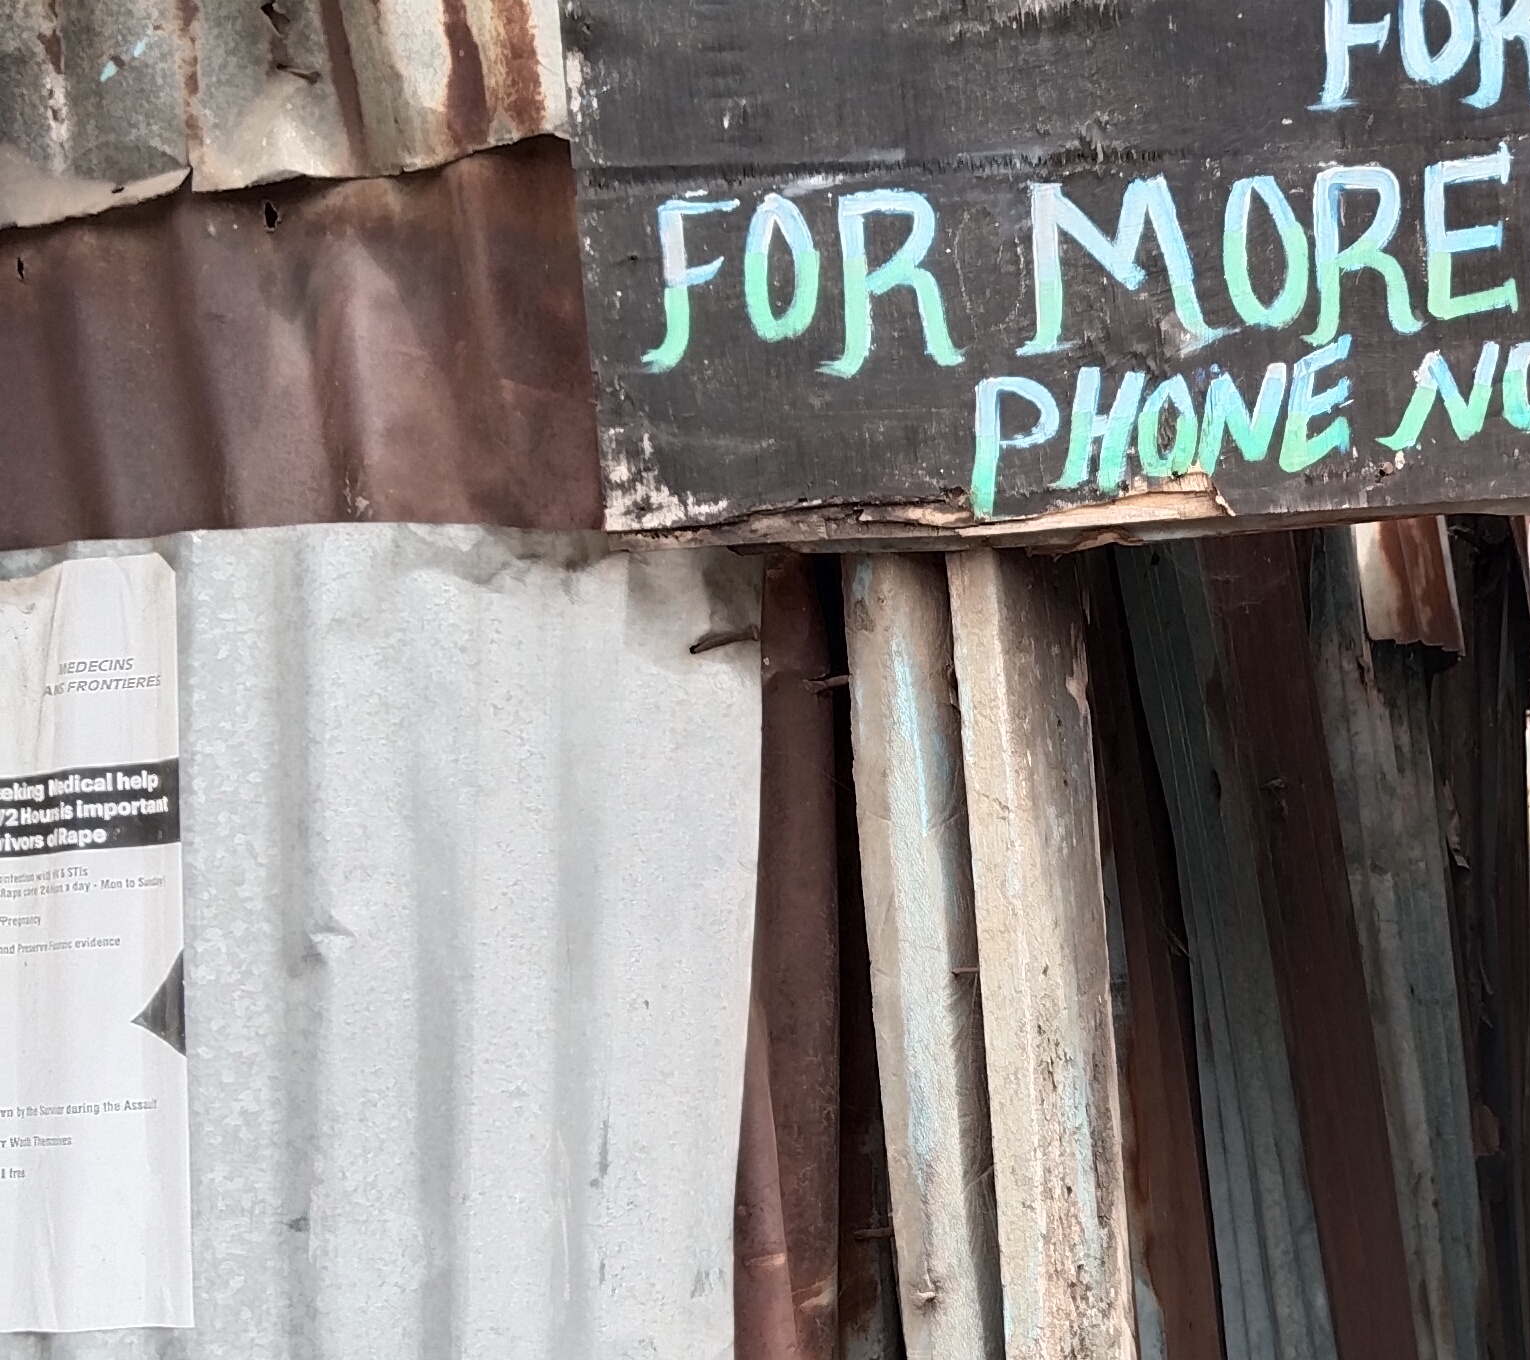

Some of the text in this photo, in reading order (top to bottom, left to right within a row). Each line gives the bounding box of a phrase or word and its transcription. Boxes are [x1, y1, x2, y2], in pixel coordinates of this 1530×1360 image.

[640, 187, 966, 379] FOR
[1015, 140, 1519, 356] MORE
[971, 334, 1353, 518] PHONE
[66, 674, 162, 693] FRONTIERES
[48, 772, 113, 798] Medical
[116, 769, 159, 792] help
[76, 795, 169, 821] important
[58, 827, 108, 848] Rape
[100, 878, 123, 890] Mon
[74, 937, 121, 949] evidence
[103, 1101, 121, 1113] the
